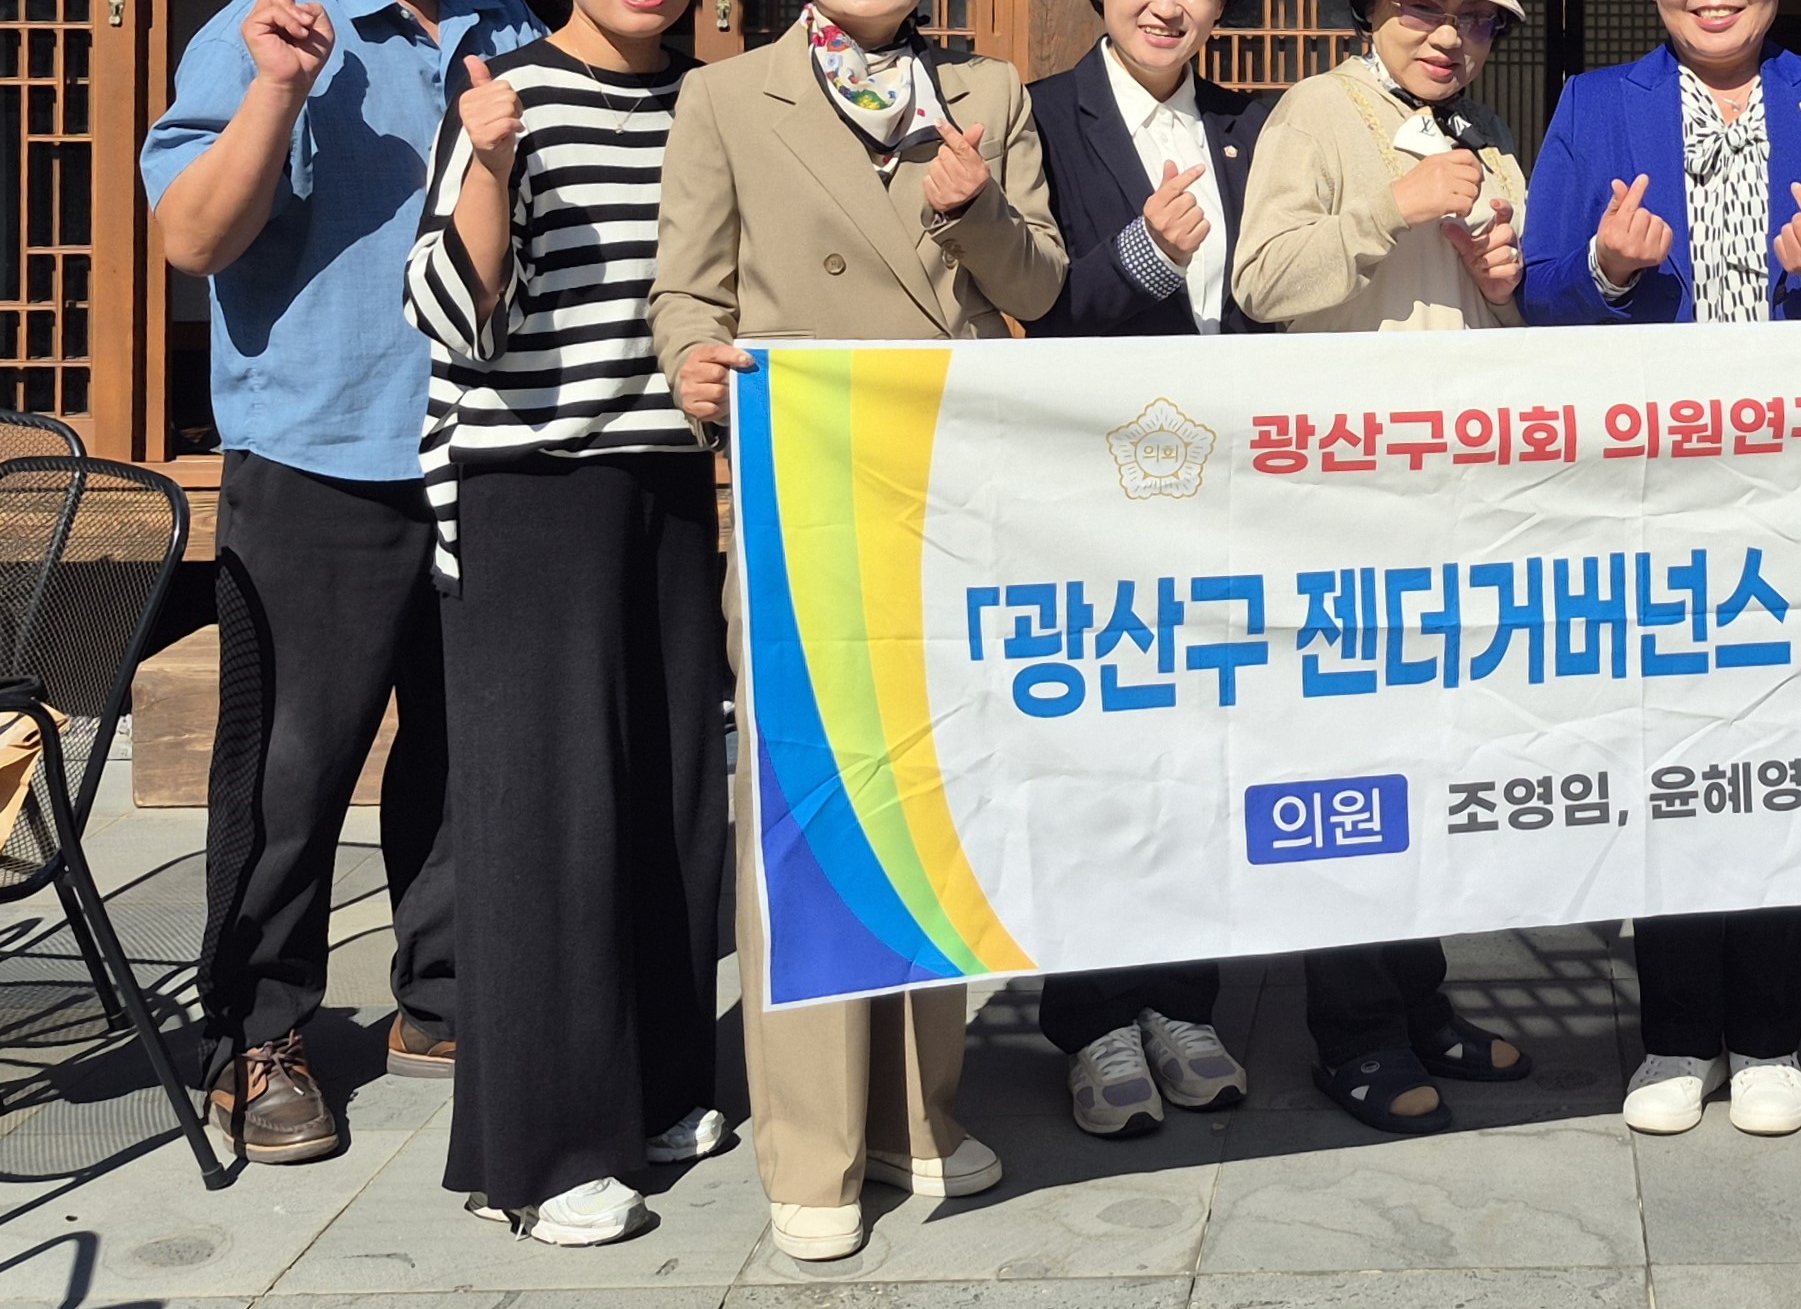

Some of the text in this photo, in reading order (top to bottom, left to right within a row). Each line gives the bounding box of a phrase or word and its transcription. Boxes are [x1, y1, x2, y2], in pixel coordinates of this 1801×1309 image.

[1141, 443, 1179, 463] 의회
[1249, 405, 1579, 476] 광산구의회
[966, 576, 1269, 719] 「광산구
[1296, 547, 1792, 699] 젠더거버넌스
[1270, 786, 1385, 850] 의원
[1447, 770, 1629, 835] 조영임,
